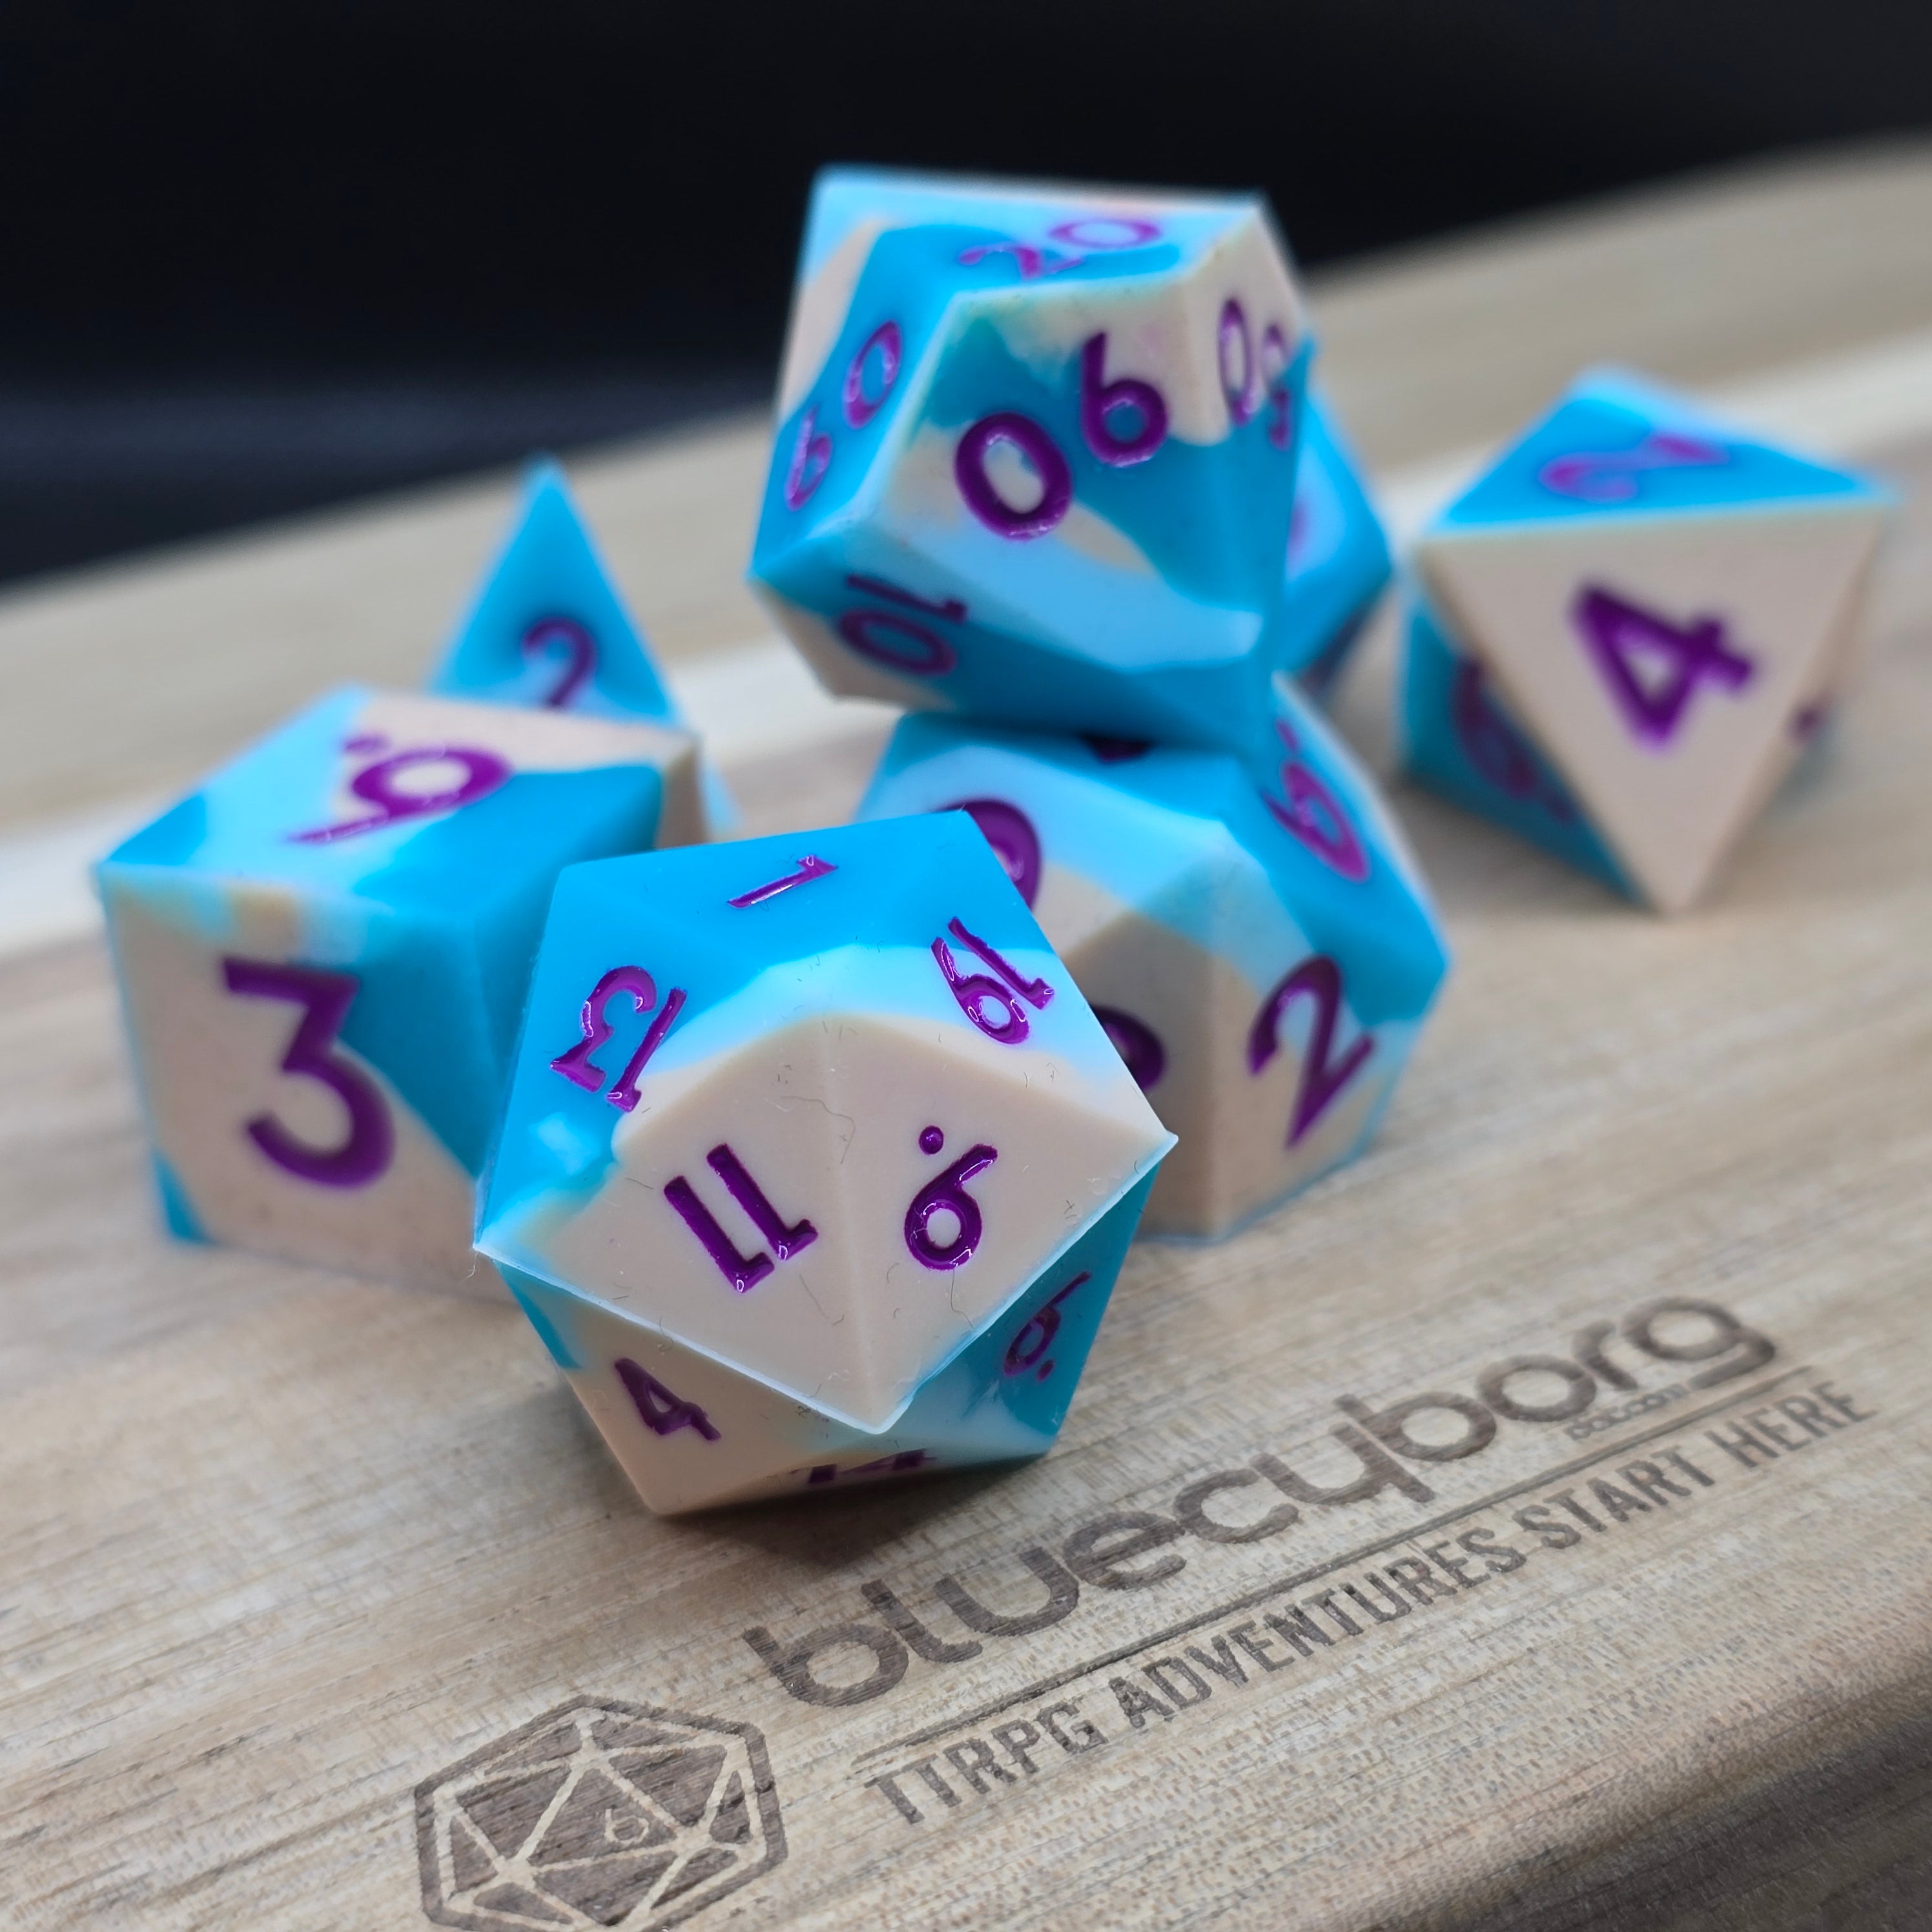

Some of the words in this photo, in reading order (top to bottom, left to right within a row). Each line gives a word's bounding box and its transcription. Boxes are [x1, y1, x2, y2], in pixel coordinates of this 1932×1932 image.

[1569, 589, 1759, 757] 4
[728, 856, 837, 909] 1
[550, 965, 686, 1114] 13
[931, 918, 1055, 1047] 19
[1246, 956, 1374, 1153] 2
[220, 957, 395, 1189] 3
[663, 1143, 819, 1294] 11
[614, 1358, 721, 1442] 4
[743, 1297, 1777, 1708] bluecyborg
[864, 1697, 1109, 1825] TTRPG
[1109, 1527, 1526, 1729] ADVENTURES
[1513, 1445, 1716, 1550] START
[1705, 1380, 1877, 1469] HERE
